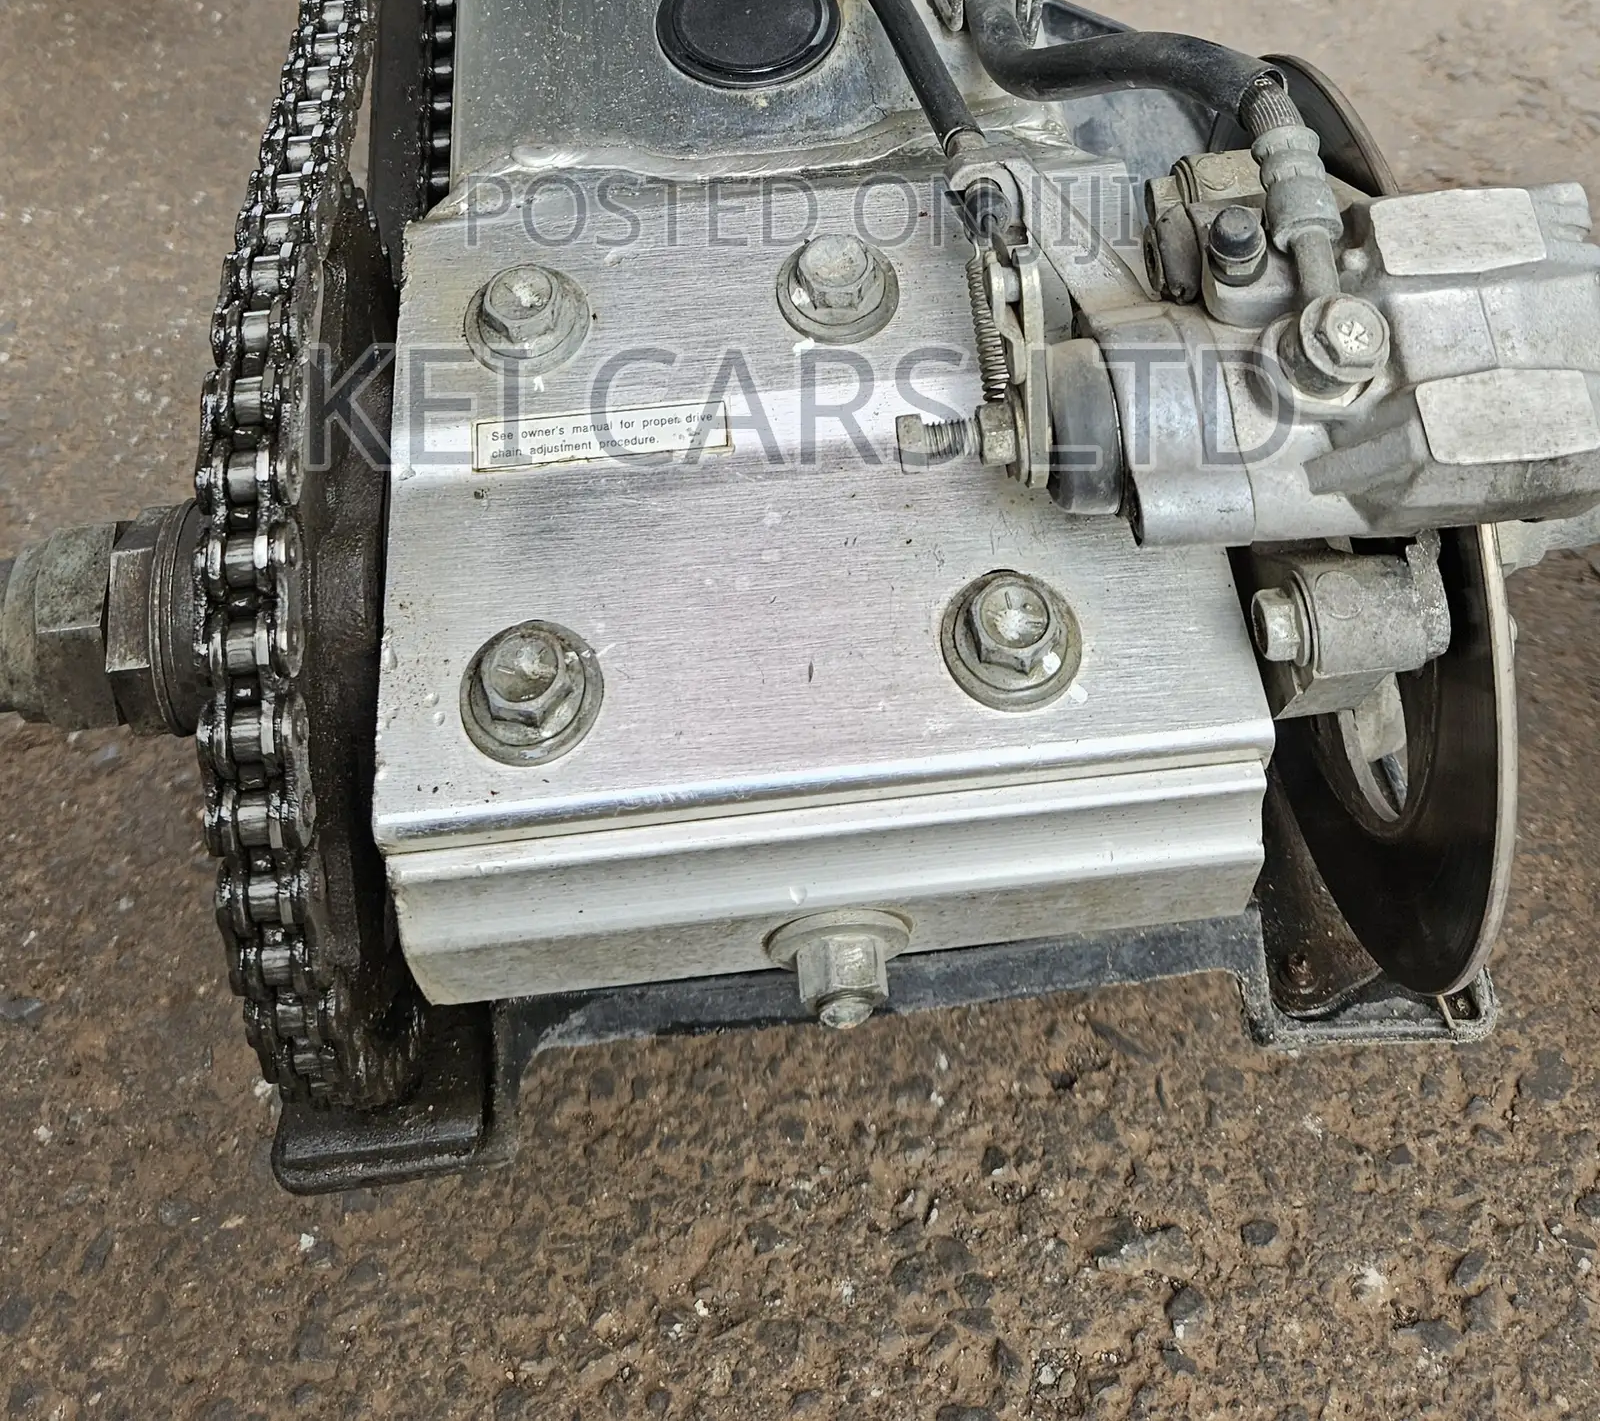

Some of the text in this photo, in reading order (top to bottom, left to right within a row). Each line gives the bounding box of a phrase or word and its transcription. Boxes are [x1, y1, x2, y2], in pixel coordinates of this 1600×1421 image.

[491, 412, 713, 442] See owner's manual for proper drive
[491, 436, 660, 459] chain adjustment procedure.
